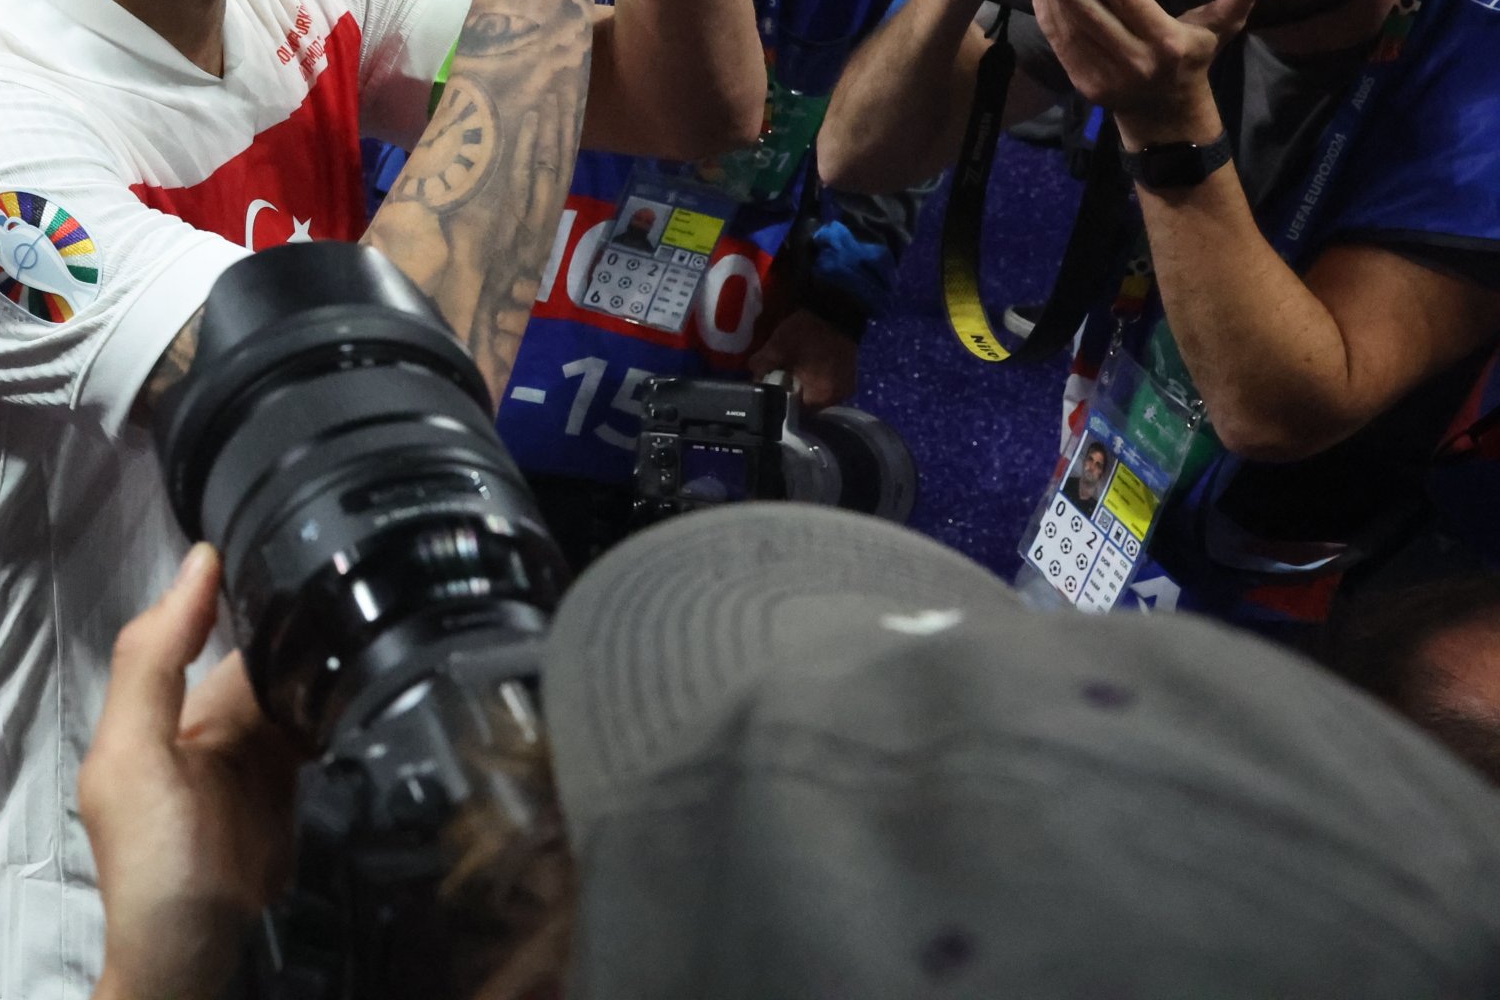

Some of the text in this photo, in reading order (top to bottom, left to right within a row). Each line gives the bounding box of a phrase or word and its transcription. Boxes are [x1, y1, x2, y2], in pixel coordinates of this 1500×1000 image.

[607, 252, 659, 277] 0 2
[590, 289, 601, 304] 6
[1055, 500, 1067, 517] 0
[1085, 530, 1098, 550] 2
[1033, 544, 1044, 561] 6
